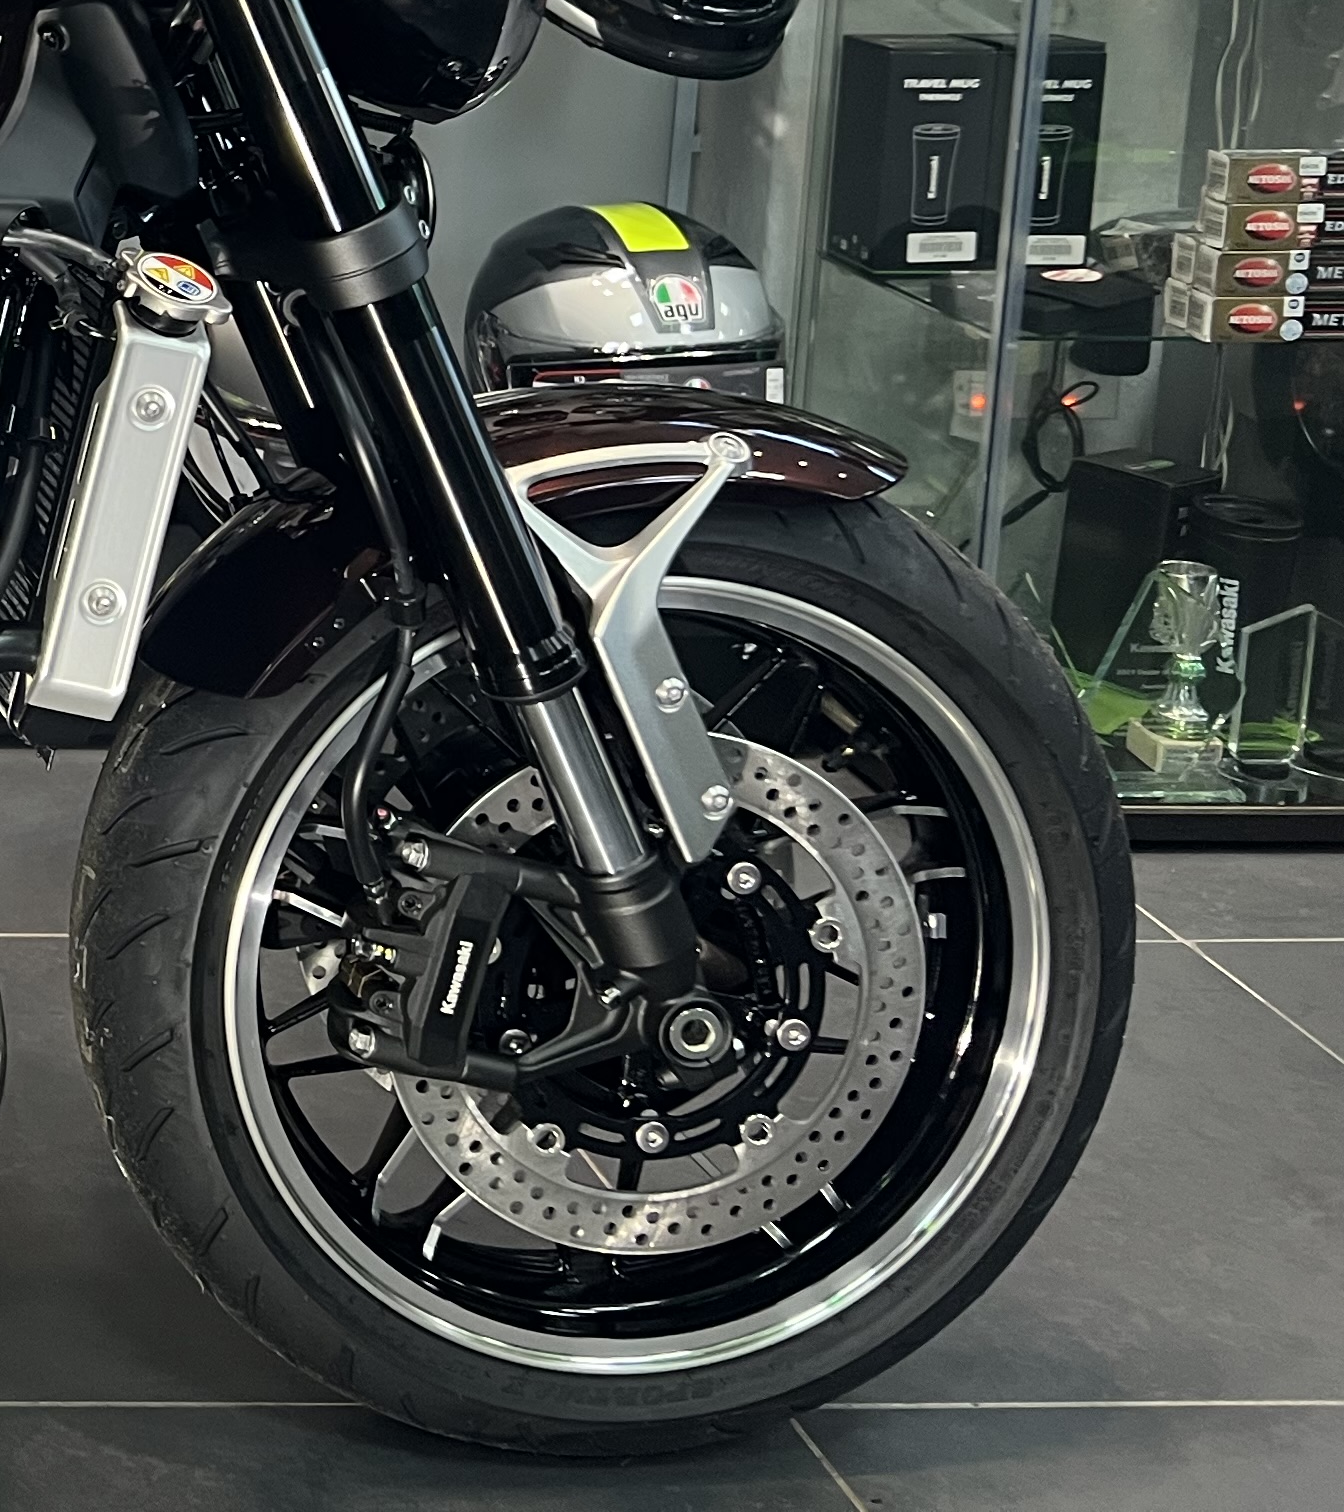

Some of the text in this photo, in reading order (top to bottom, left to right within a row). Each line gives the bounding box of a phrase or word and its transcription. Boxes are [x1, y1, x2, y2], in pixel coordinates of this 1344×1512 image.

[903, 78, 981, 89] TRAVEL MUG
[1062, 79, 1093, 89] MUG
[439, 940, 475, 1016] Kawasaki
